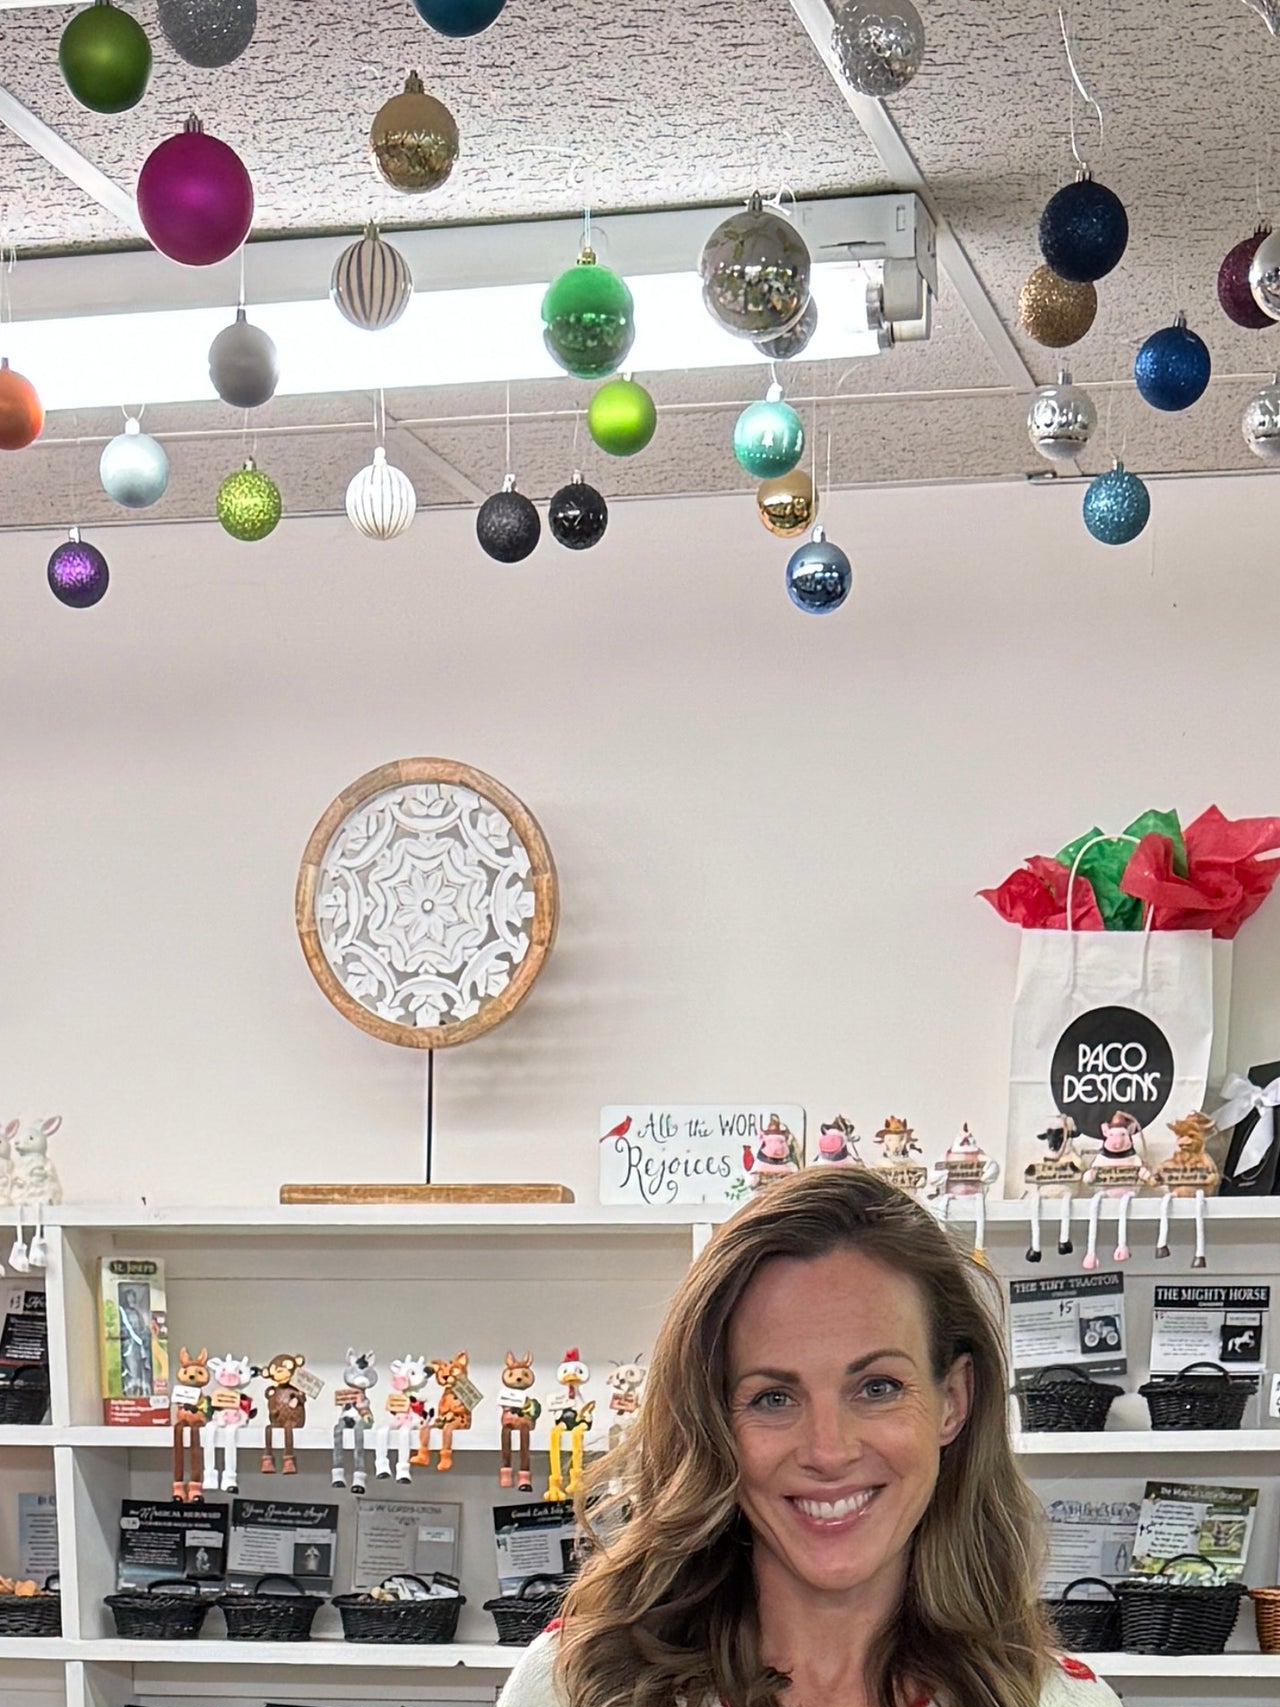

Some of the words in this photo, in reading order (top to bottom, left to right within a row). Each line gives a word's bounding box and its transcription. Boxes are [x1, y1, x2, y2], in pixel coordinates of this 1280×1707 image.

[1077, 1042, 1148, 1074] PACO
[1062, 1073, 1161, 1104] DESIGNS
[637, 1112, 678, 1144] All
[615, 1136, 732, 1204] Rejoices
[1013, 1282, 1037, 1294] THE
[1039, 1279, 1065, 1292] TINY
[1068, 1274, 1120, 1289] TRACTOR
[1156, 1288, 1180, 1301] THE
[1181, 1288, 1228, 1301] MIGHTY
[1229, 1288, 1268, 1301] HORSE
